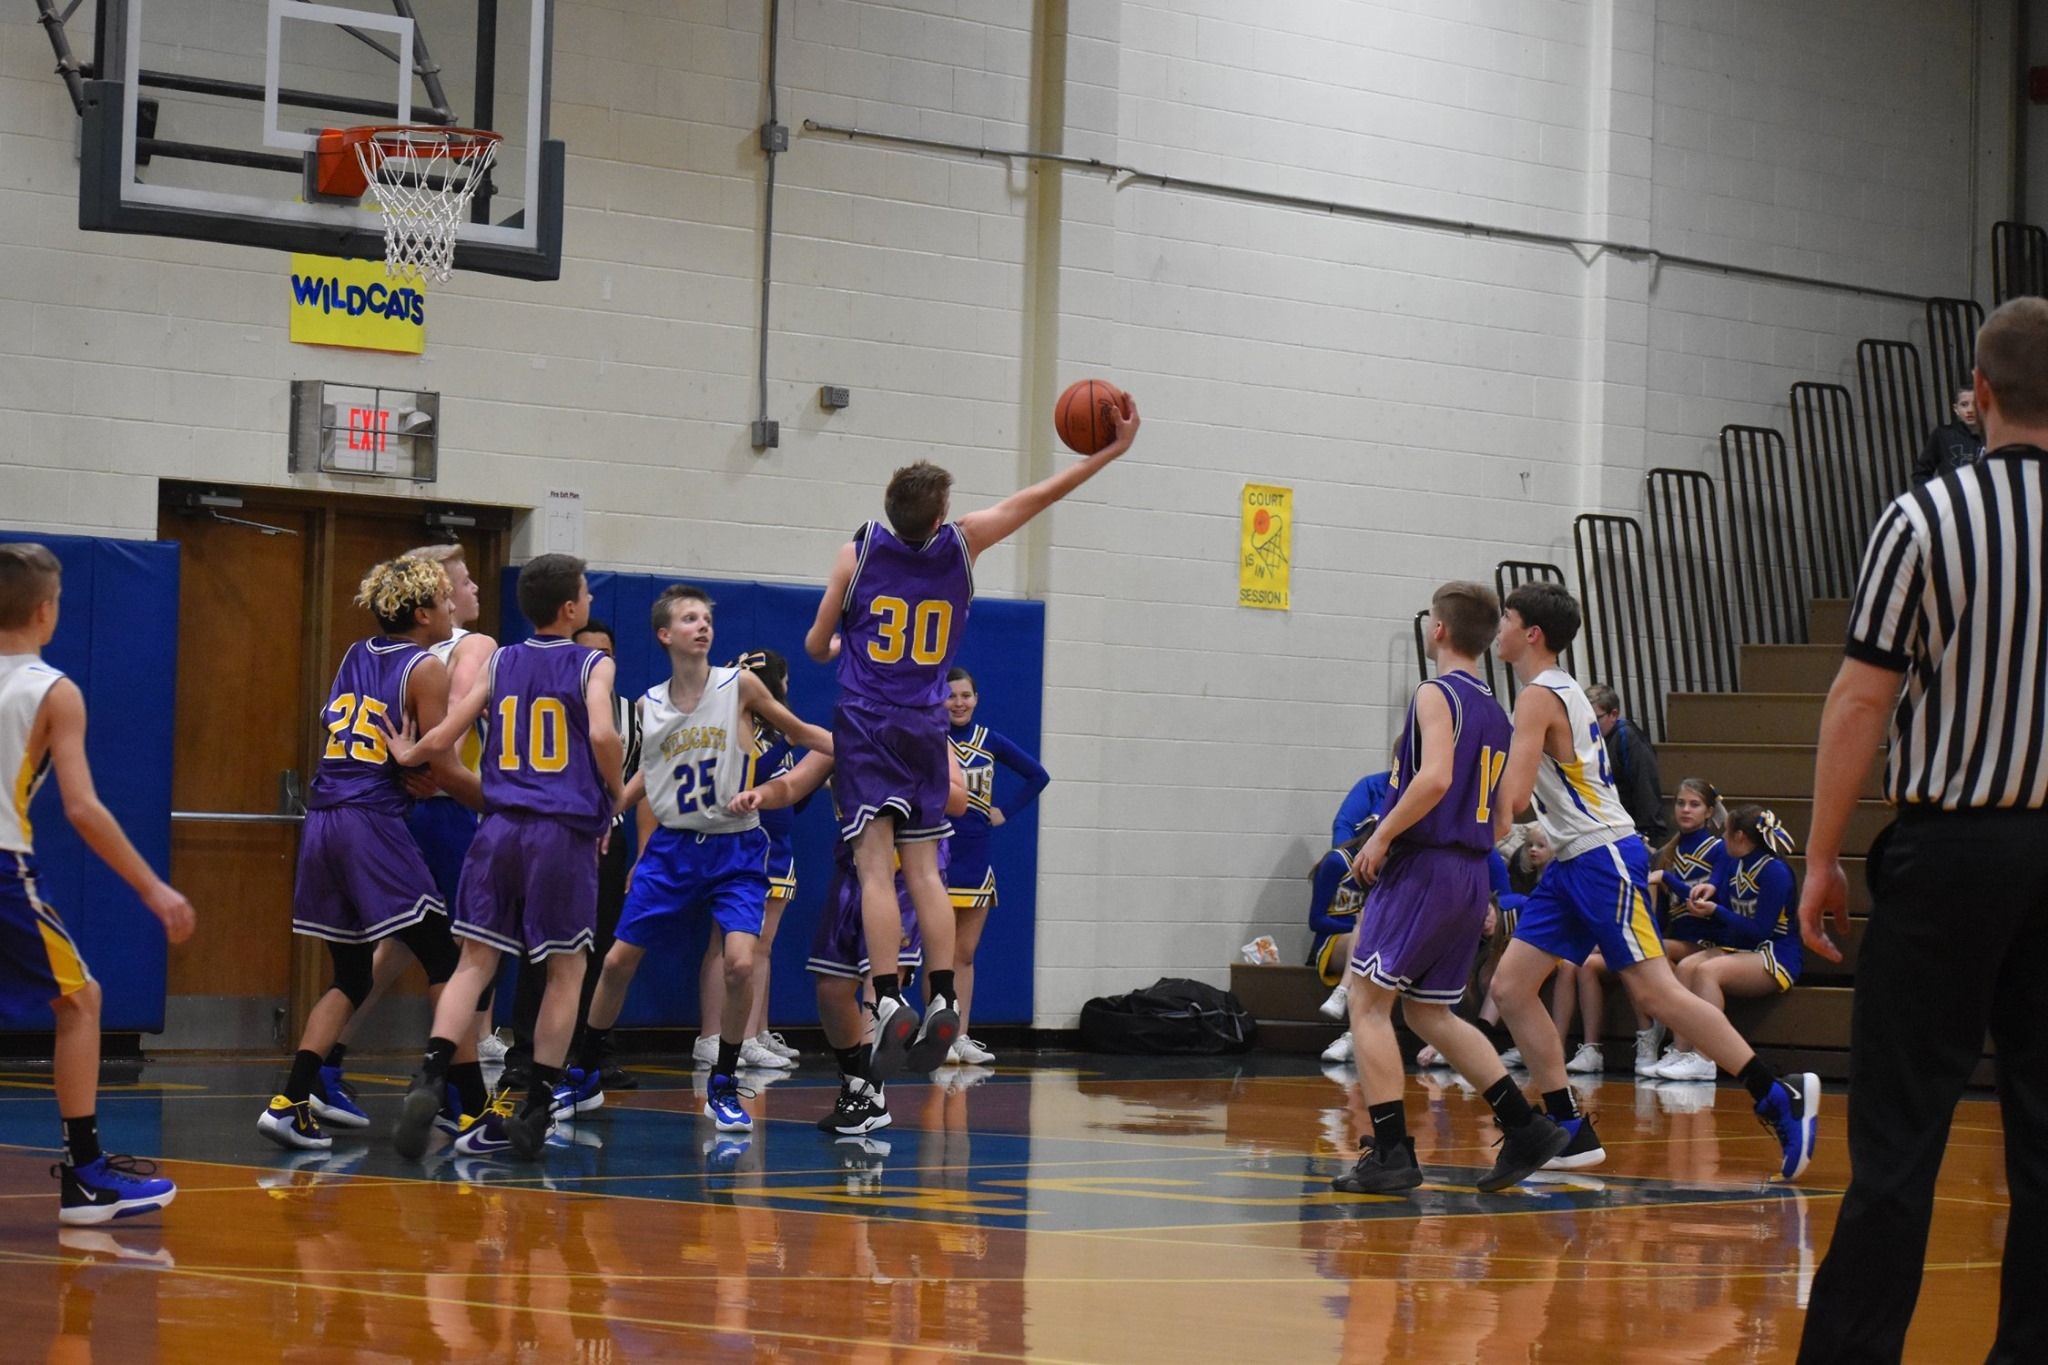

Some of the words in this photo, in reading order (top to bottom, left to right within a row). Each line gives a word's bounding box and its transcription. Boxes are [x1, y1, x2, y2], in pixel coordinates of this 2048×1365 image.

[291, 274, 424, 326] WILDCATS
[349, 408, 389, 452] EXIT
[1248, 493, 1285, 507] COURT
[1245, 553, 1255, 567] IS
[1255, 565, 1266, 579] IN
[867, 595, 953, 665] 30
[323, 692, 389, 765] 25
[499, 695, 569, 773] 10
[673, 757, 718, 815] 25
